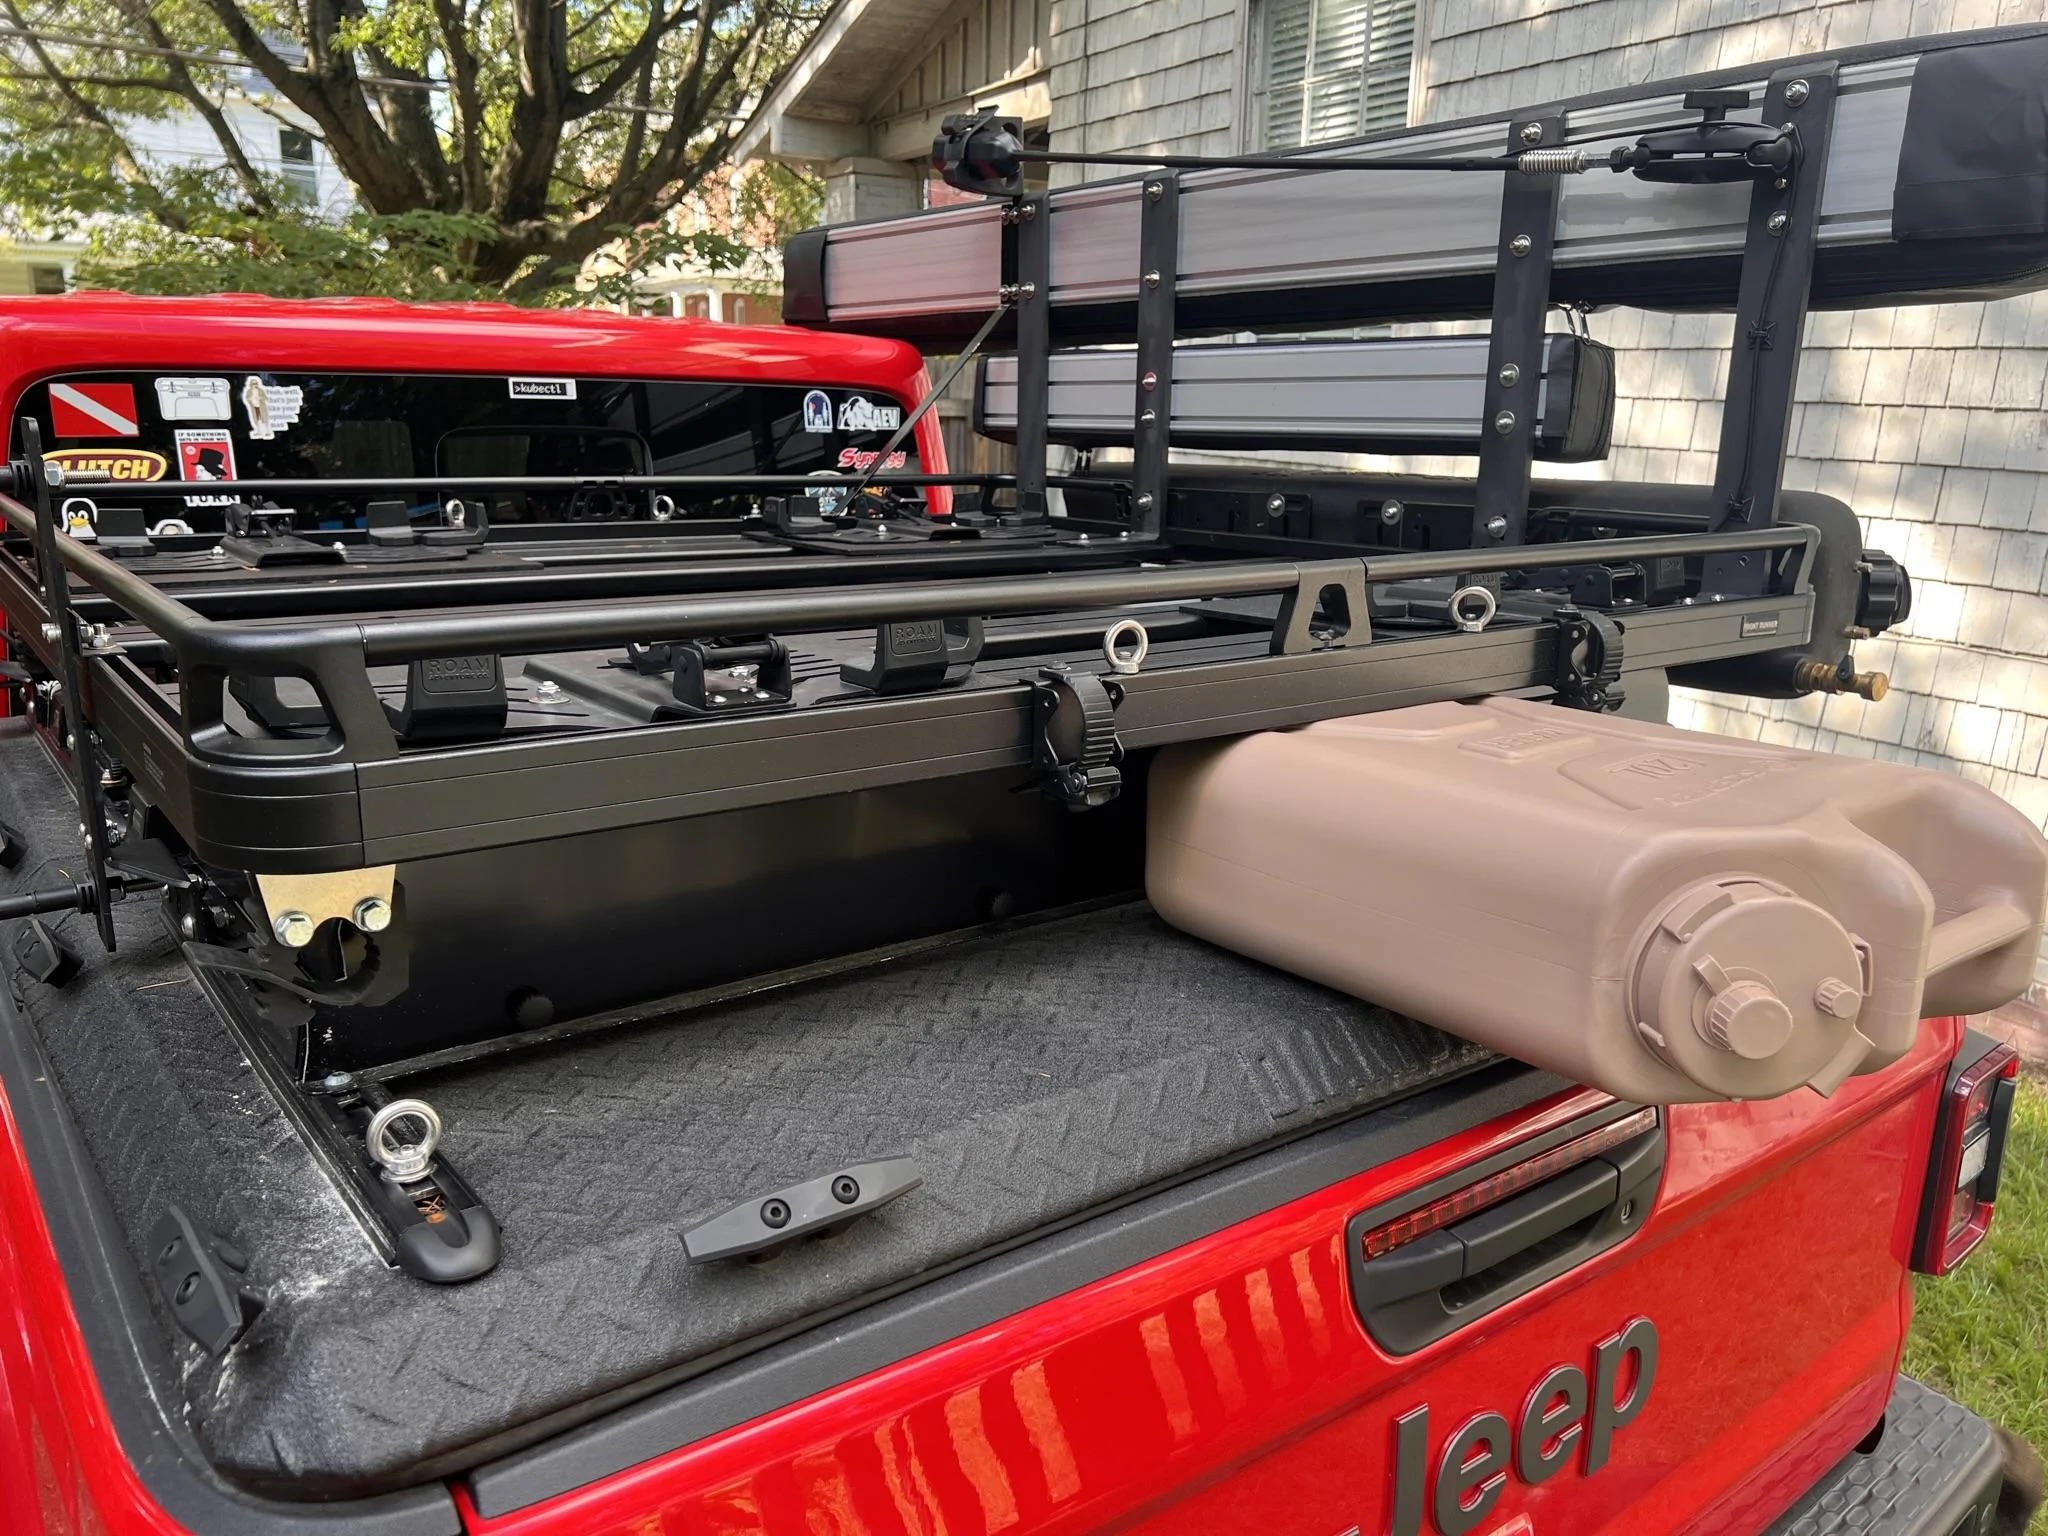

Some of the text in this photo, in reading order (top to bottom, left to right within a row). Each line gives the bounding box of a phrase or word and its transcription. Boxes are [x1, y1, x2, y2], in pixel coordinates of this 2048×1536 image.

[48, 459, 151, 480] LUTCH
[428, 657, 489, 674] ROAM
[1333, 1314, 1659, 1536] Jeep
